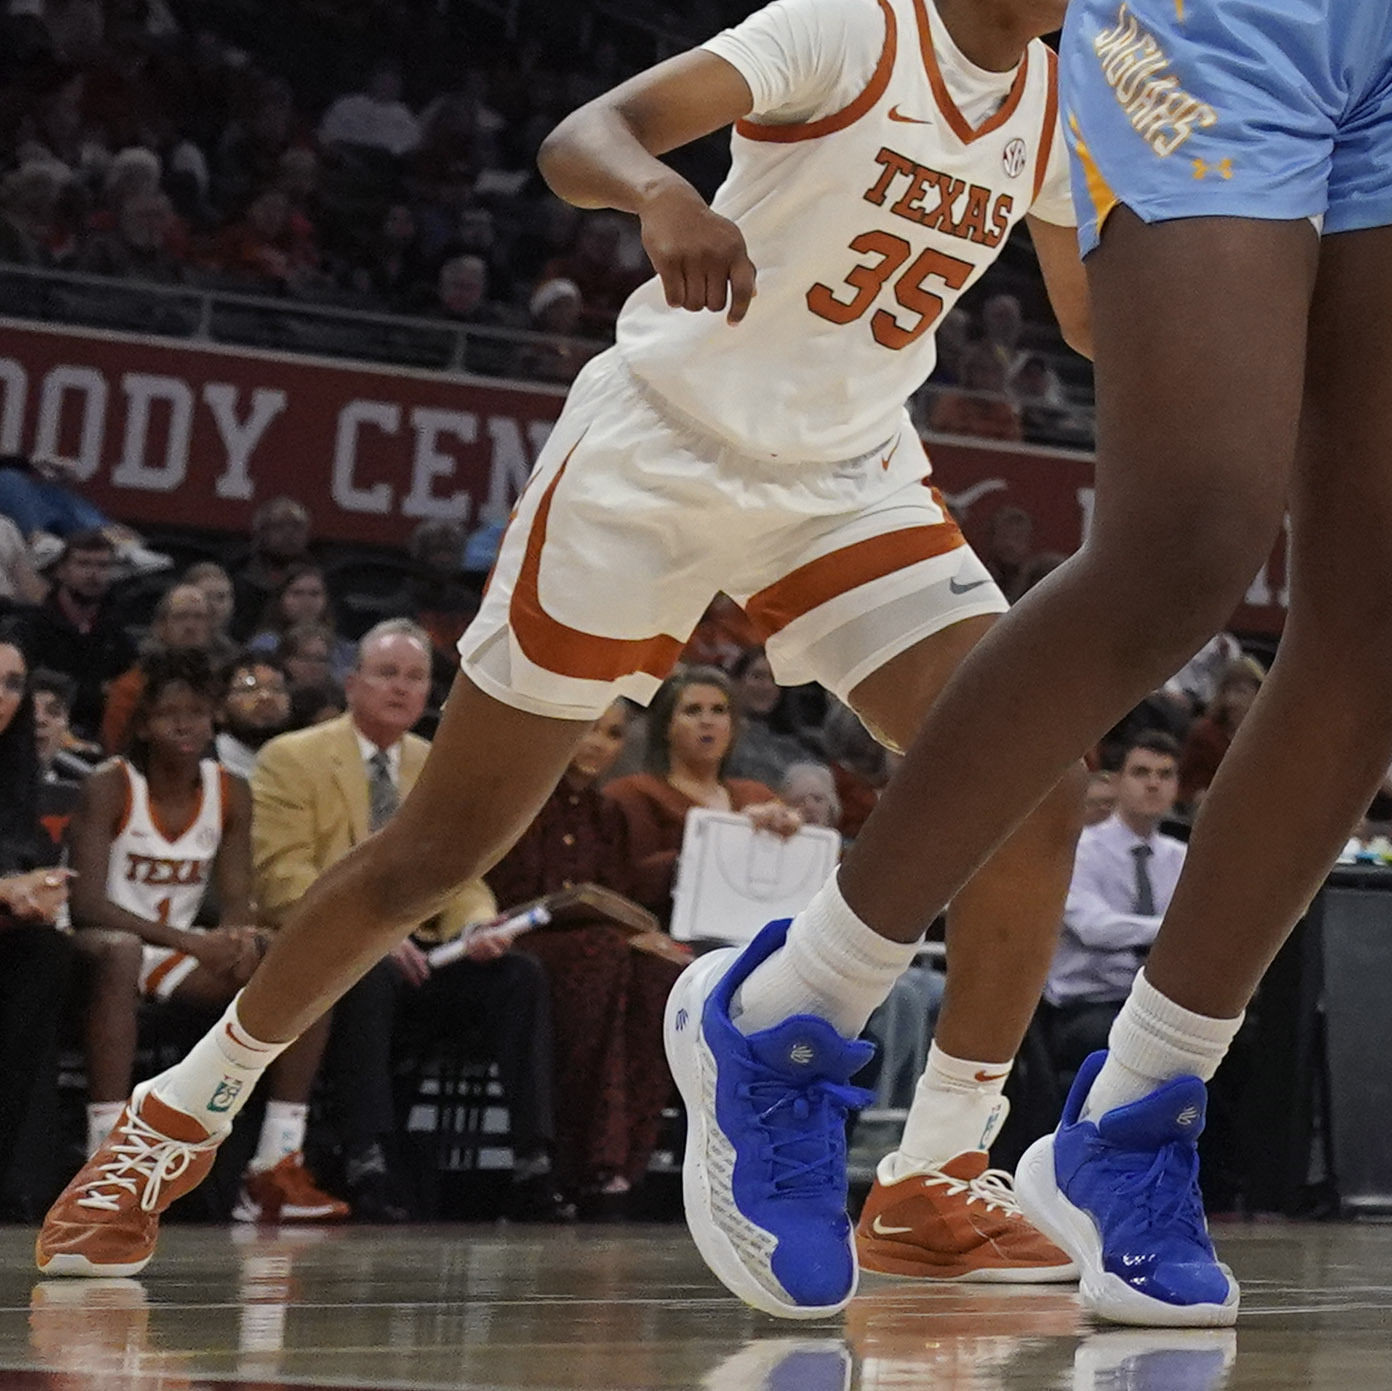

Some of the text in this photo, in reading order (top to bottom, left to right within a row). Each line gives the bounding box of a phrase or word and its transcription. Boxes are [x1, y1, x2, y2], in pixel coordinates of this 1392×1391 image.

[863, 146, 1014, 249] TEXAS
[806, 229, 976, 351] 35
[330, 399, 560, 521] CEN
[127, 853, 203, 886] TEXA
